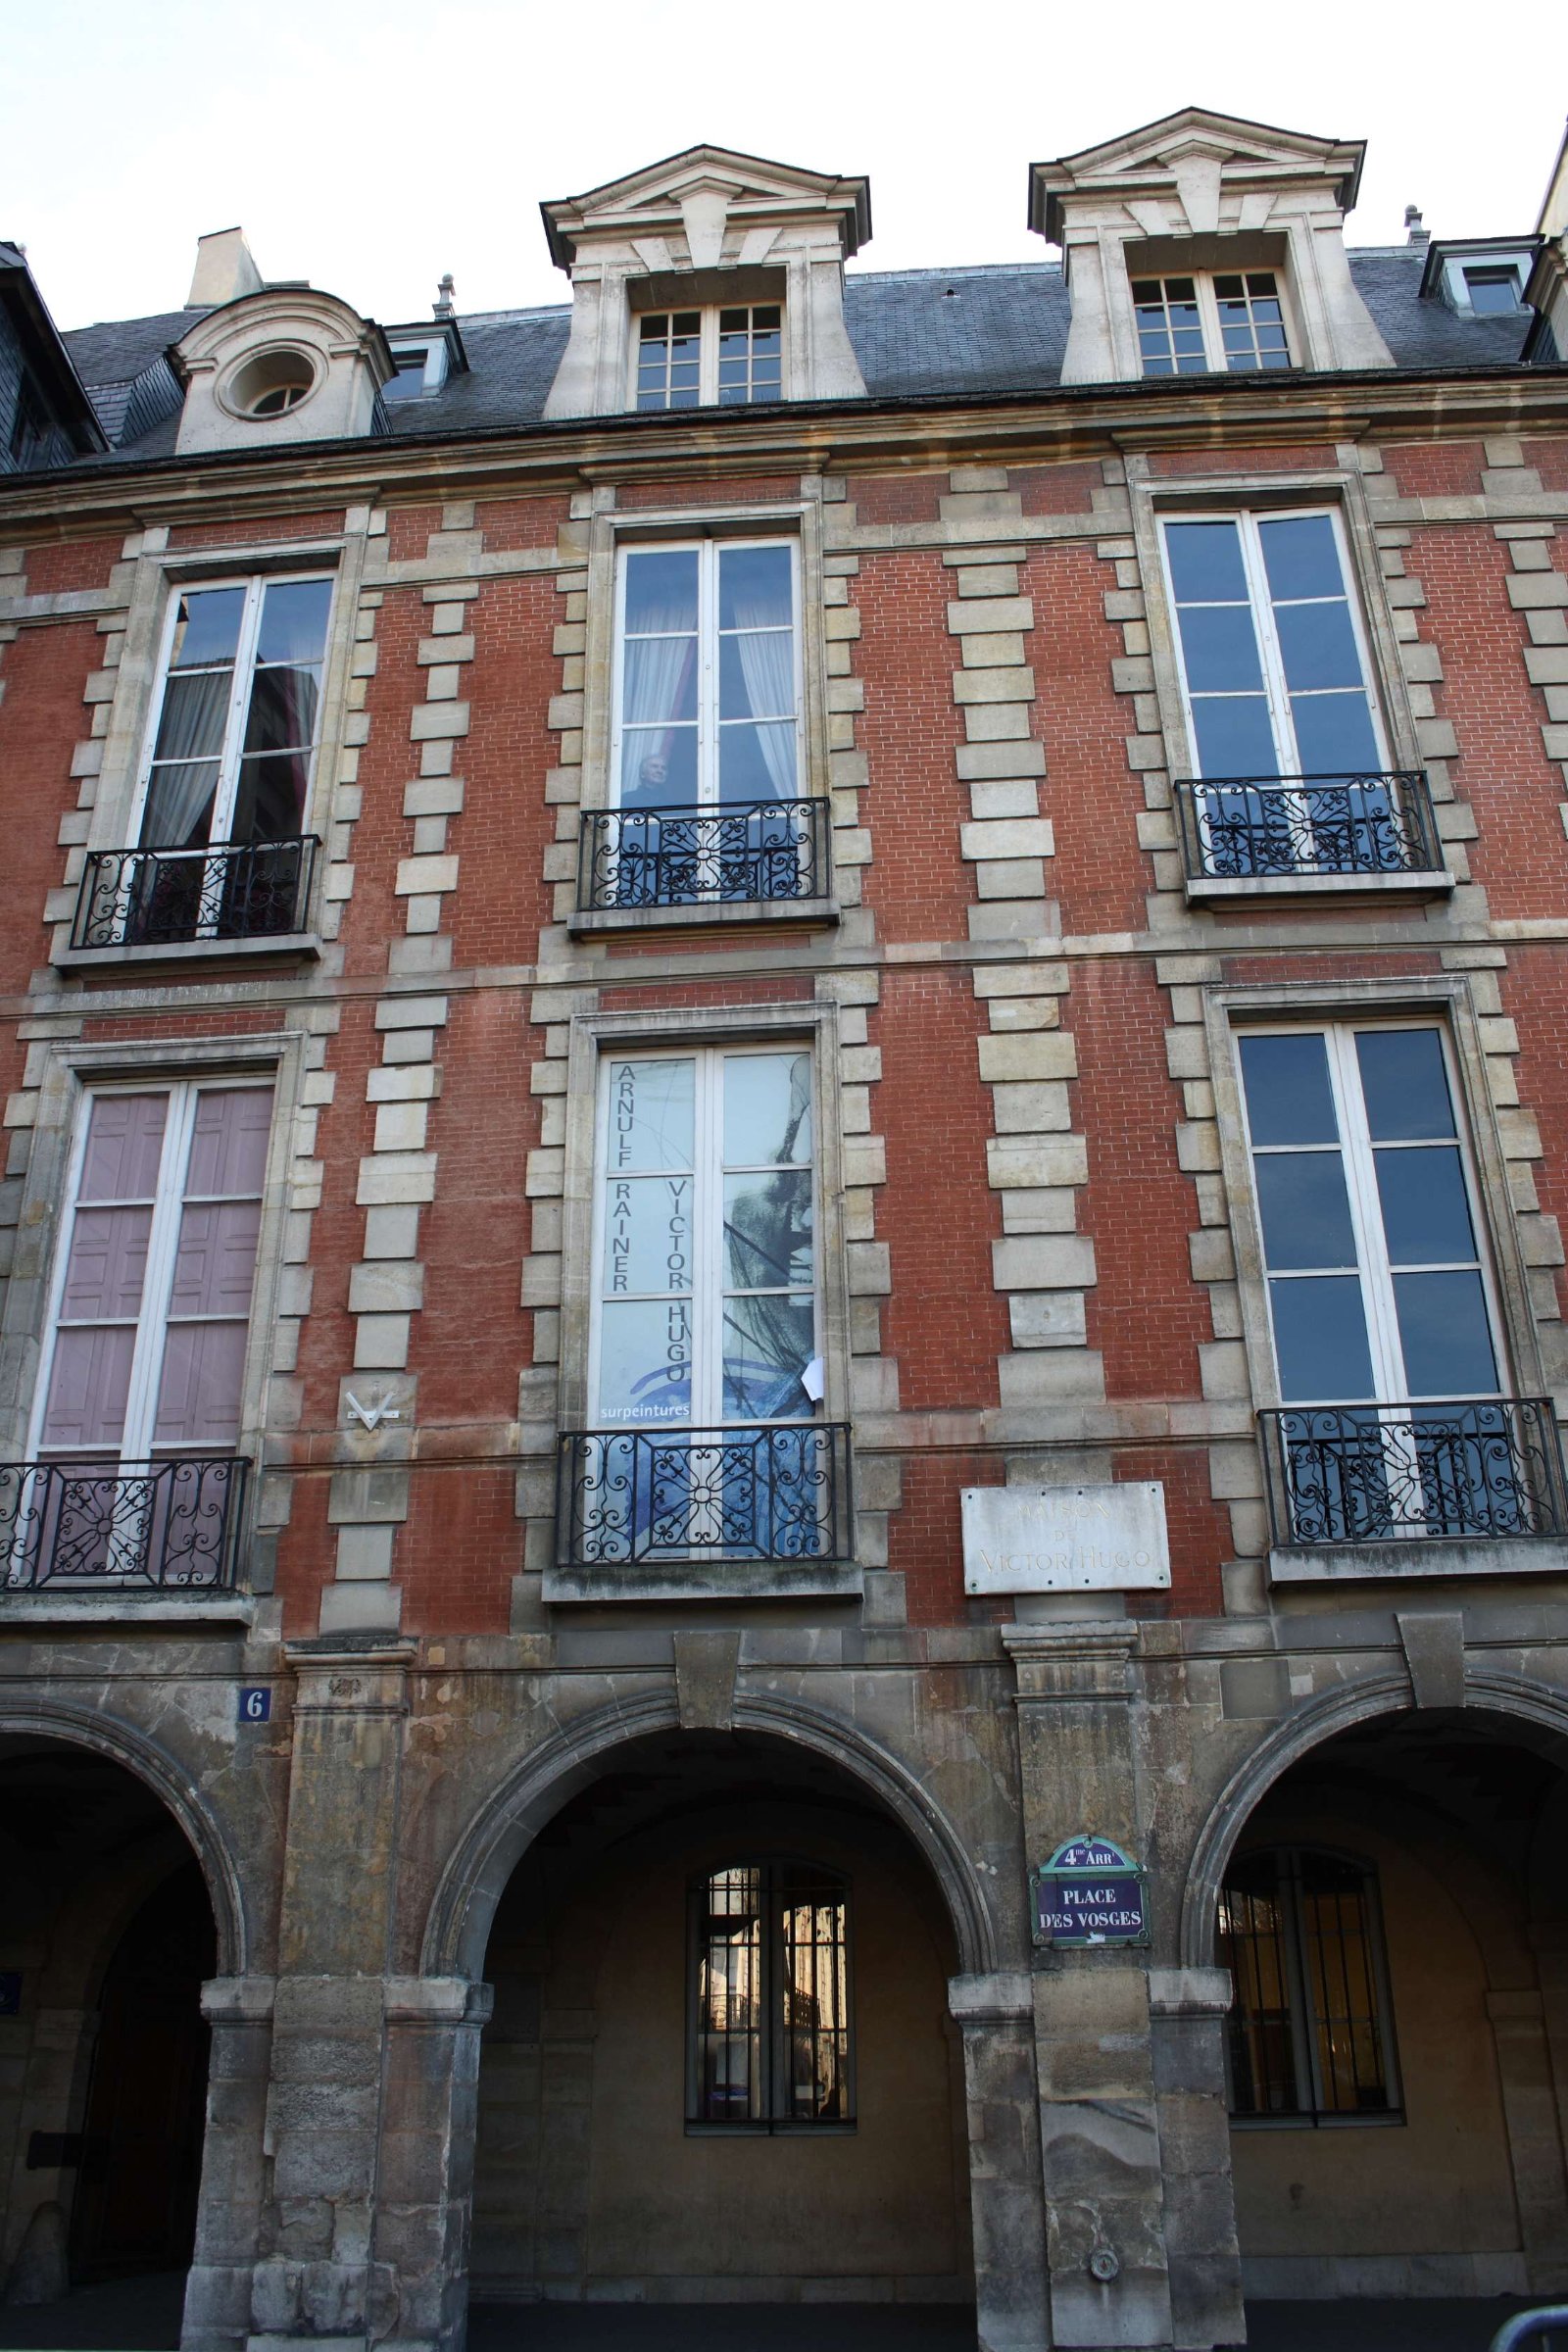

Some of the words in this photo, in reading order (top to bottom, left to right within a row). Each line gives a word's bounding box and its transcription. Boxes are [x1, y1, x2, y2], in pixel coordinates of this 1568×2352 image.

[617, 1065, 635, 1167] ARNULF
[612, 1183, 631, 1292] RAINER
[667, 1180, 687, 1290] VICTOR
[666, 1305, 685, 1382] HUGO
[601, 1403, 690, 1421] surpeintures
[247, 1691, 263, 1717] 6
[1040, 1913, 1074, 1929] DES
[1077, 1910, 1142, 1928] VOSGES
[1062, 1888, 1117, 1905] PLACE
